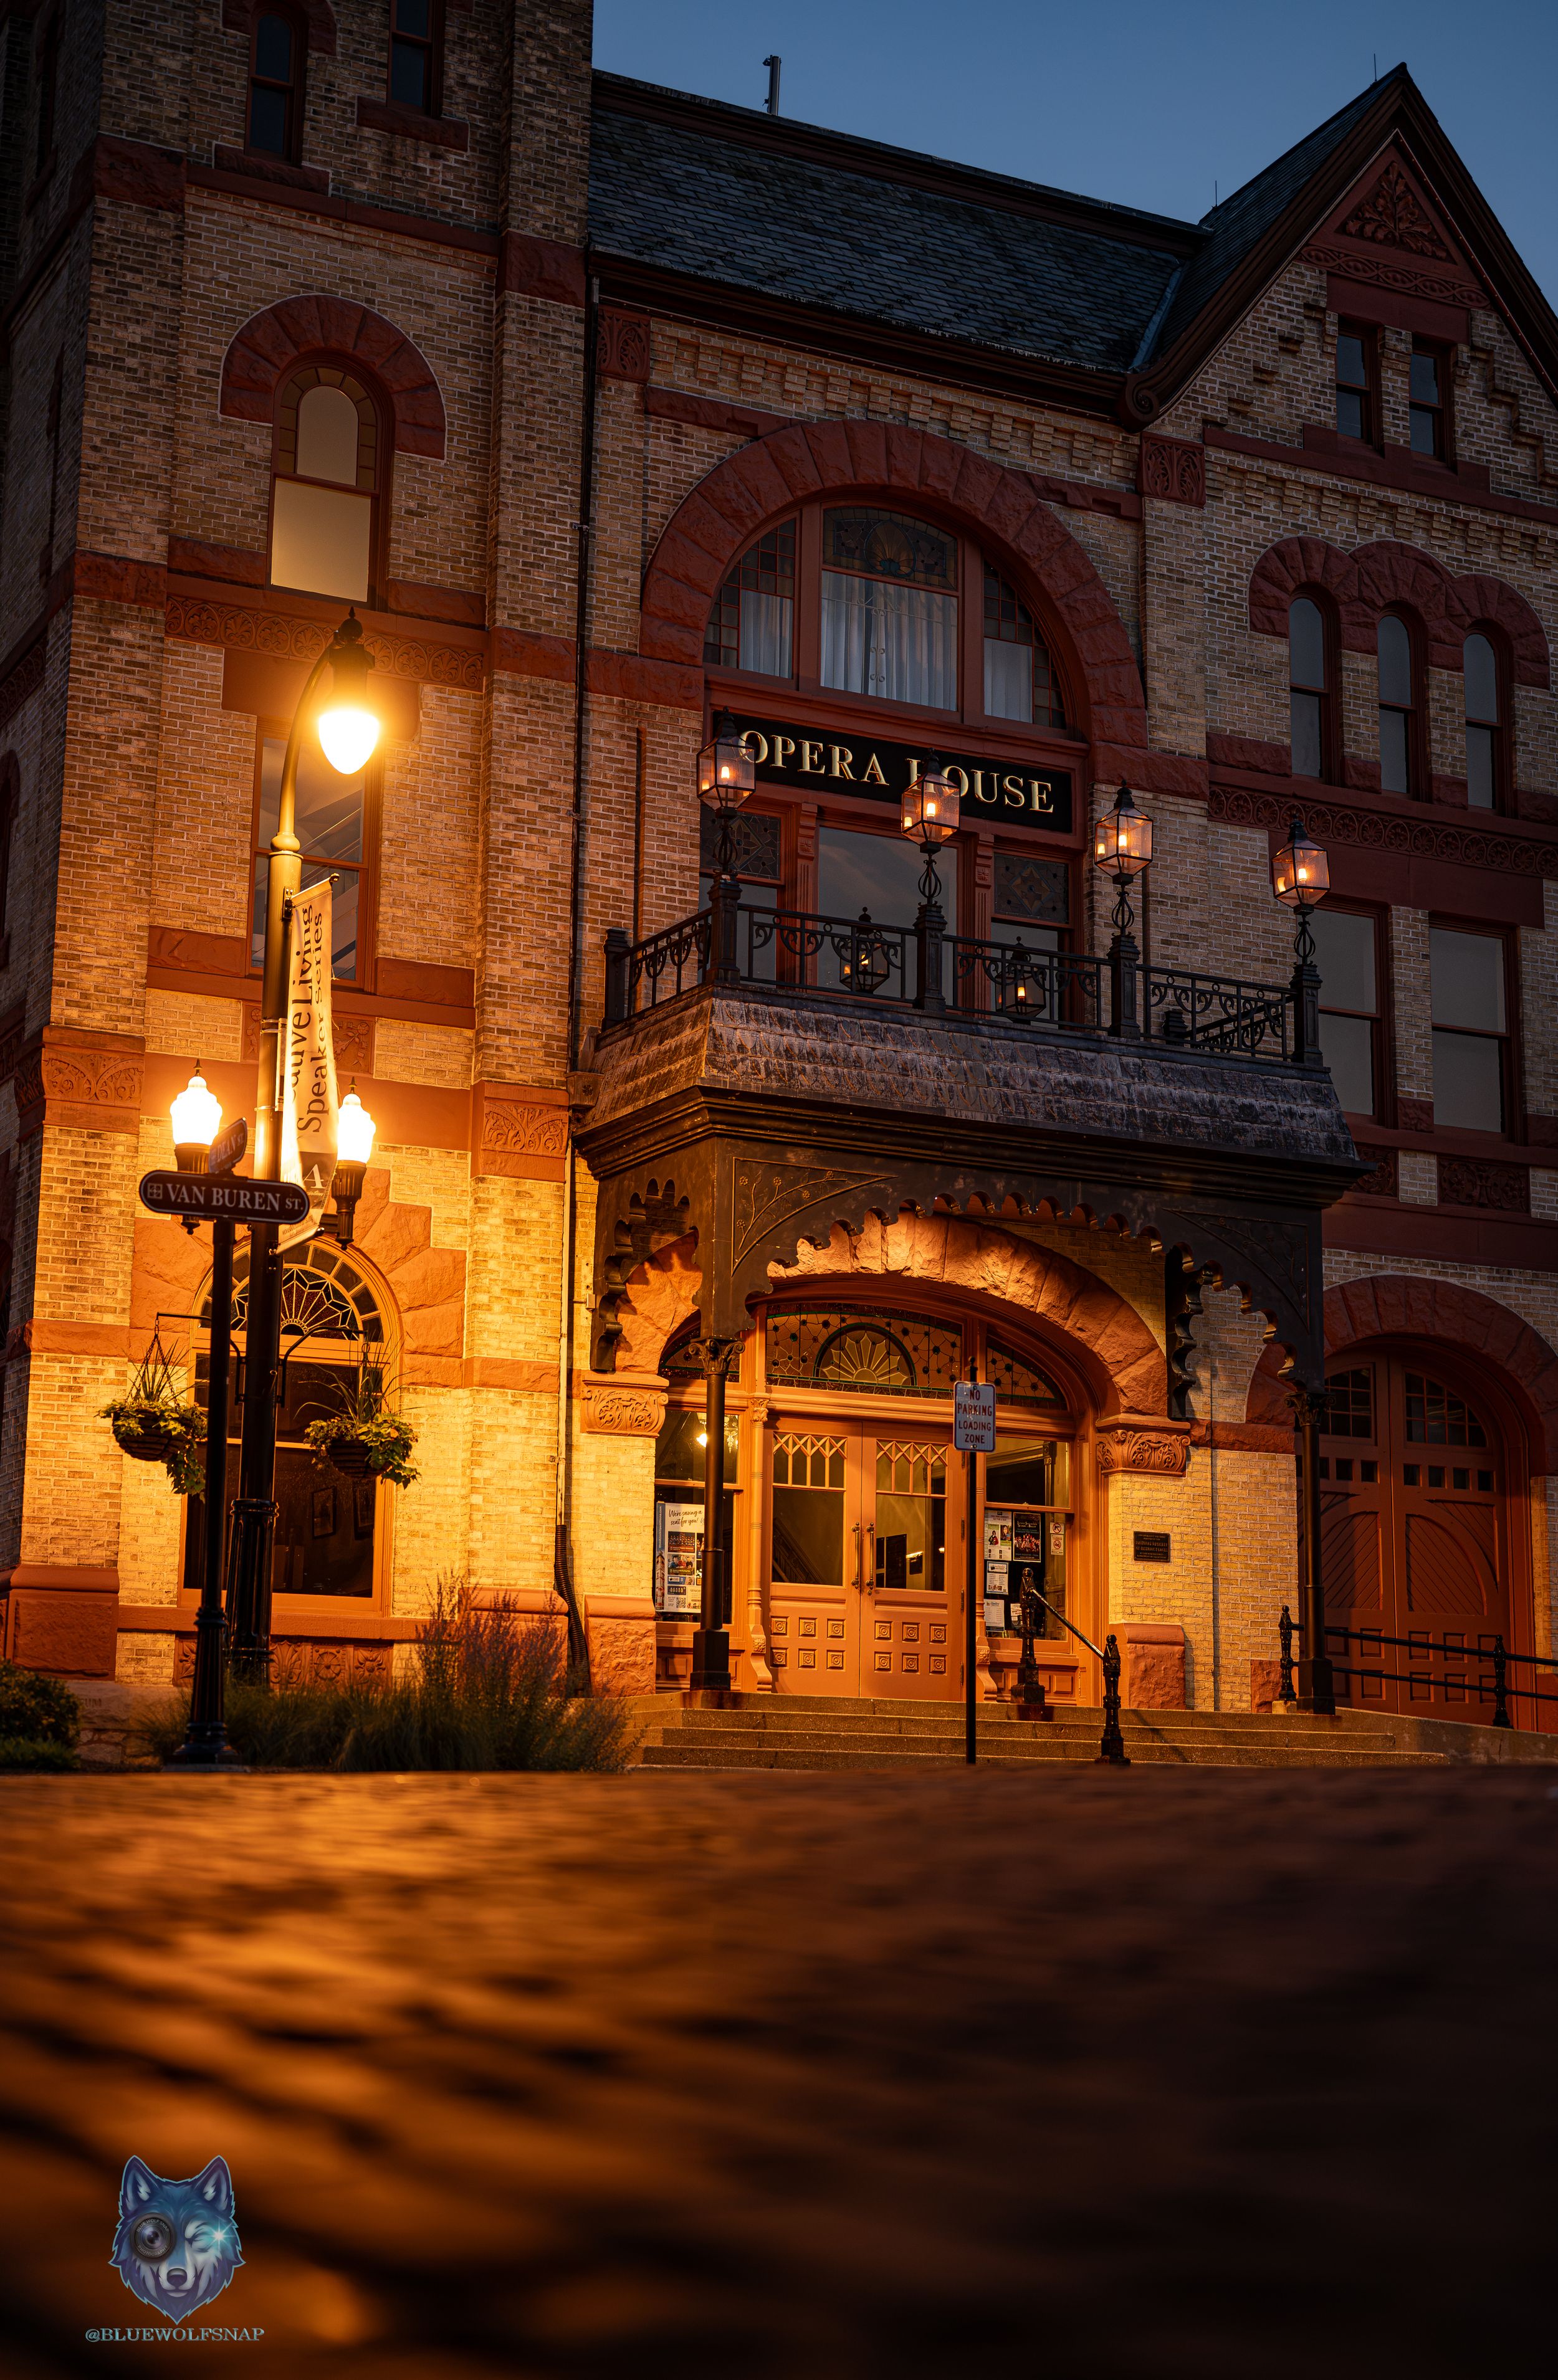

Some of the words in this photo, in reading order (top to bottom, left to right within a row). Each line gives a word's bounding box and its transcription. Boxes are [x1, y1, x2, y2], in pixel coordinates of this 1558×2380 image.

[738, 730, 890, 786] OPERA
[905, 758, 1054, 812] HOUSE
[297, 1013, 329, 1133] Speaker
[166, 1184, 205, 1204] VAN
[211, 1188, 281, 1211] BUREN
[285, 1197, 303, 1210] ST.
[970, 1389, 980, 1401] NO
[958, 1403, 992, 1416] PARKING
[958, 1421, 991, 1431] LOADING
[965, 1434, 985, 1444] ZONE
[688, 1517, 699, 1525] you!
